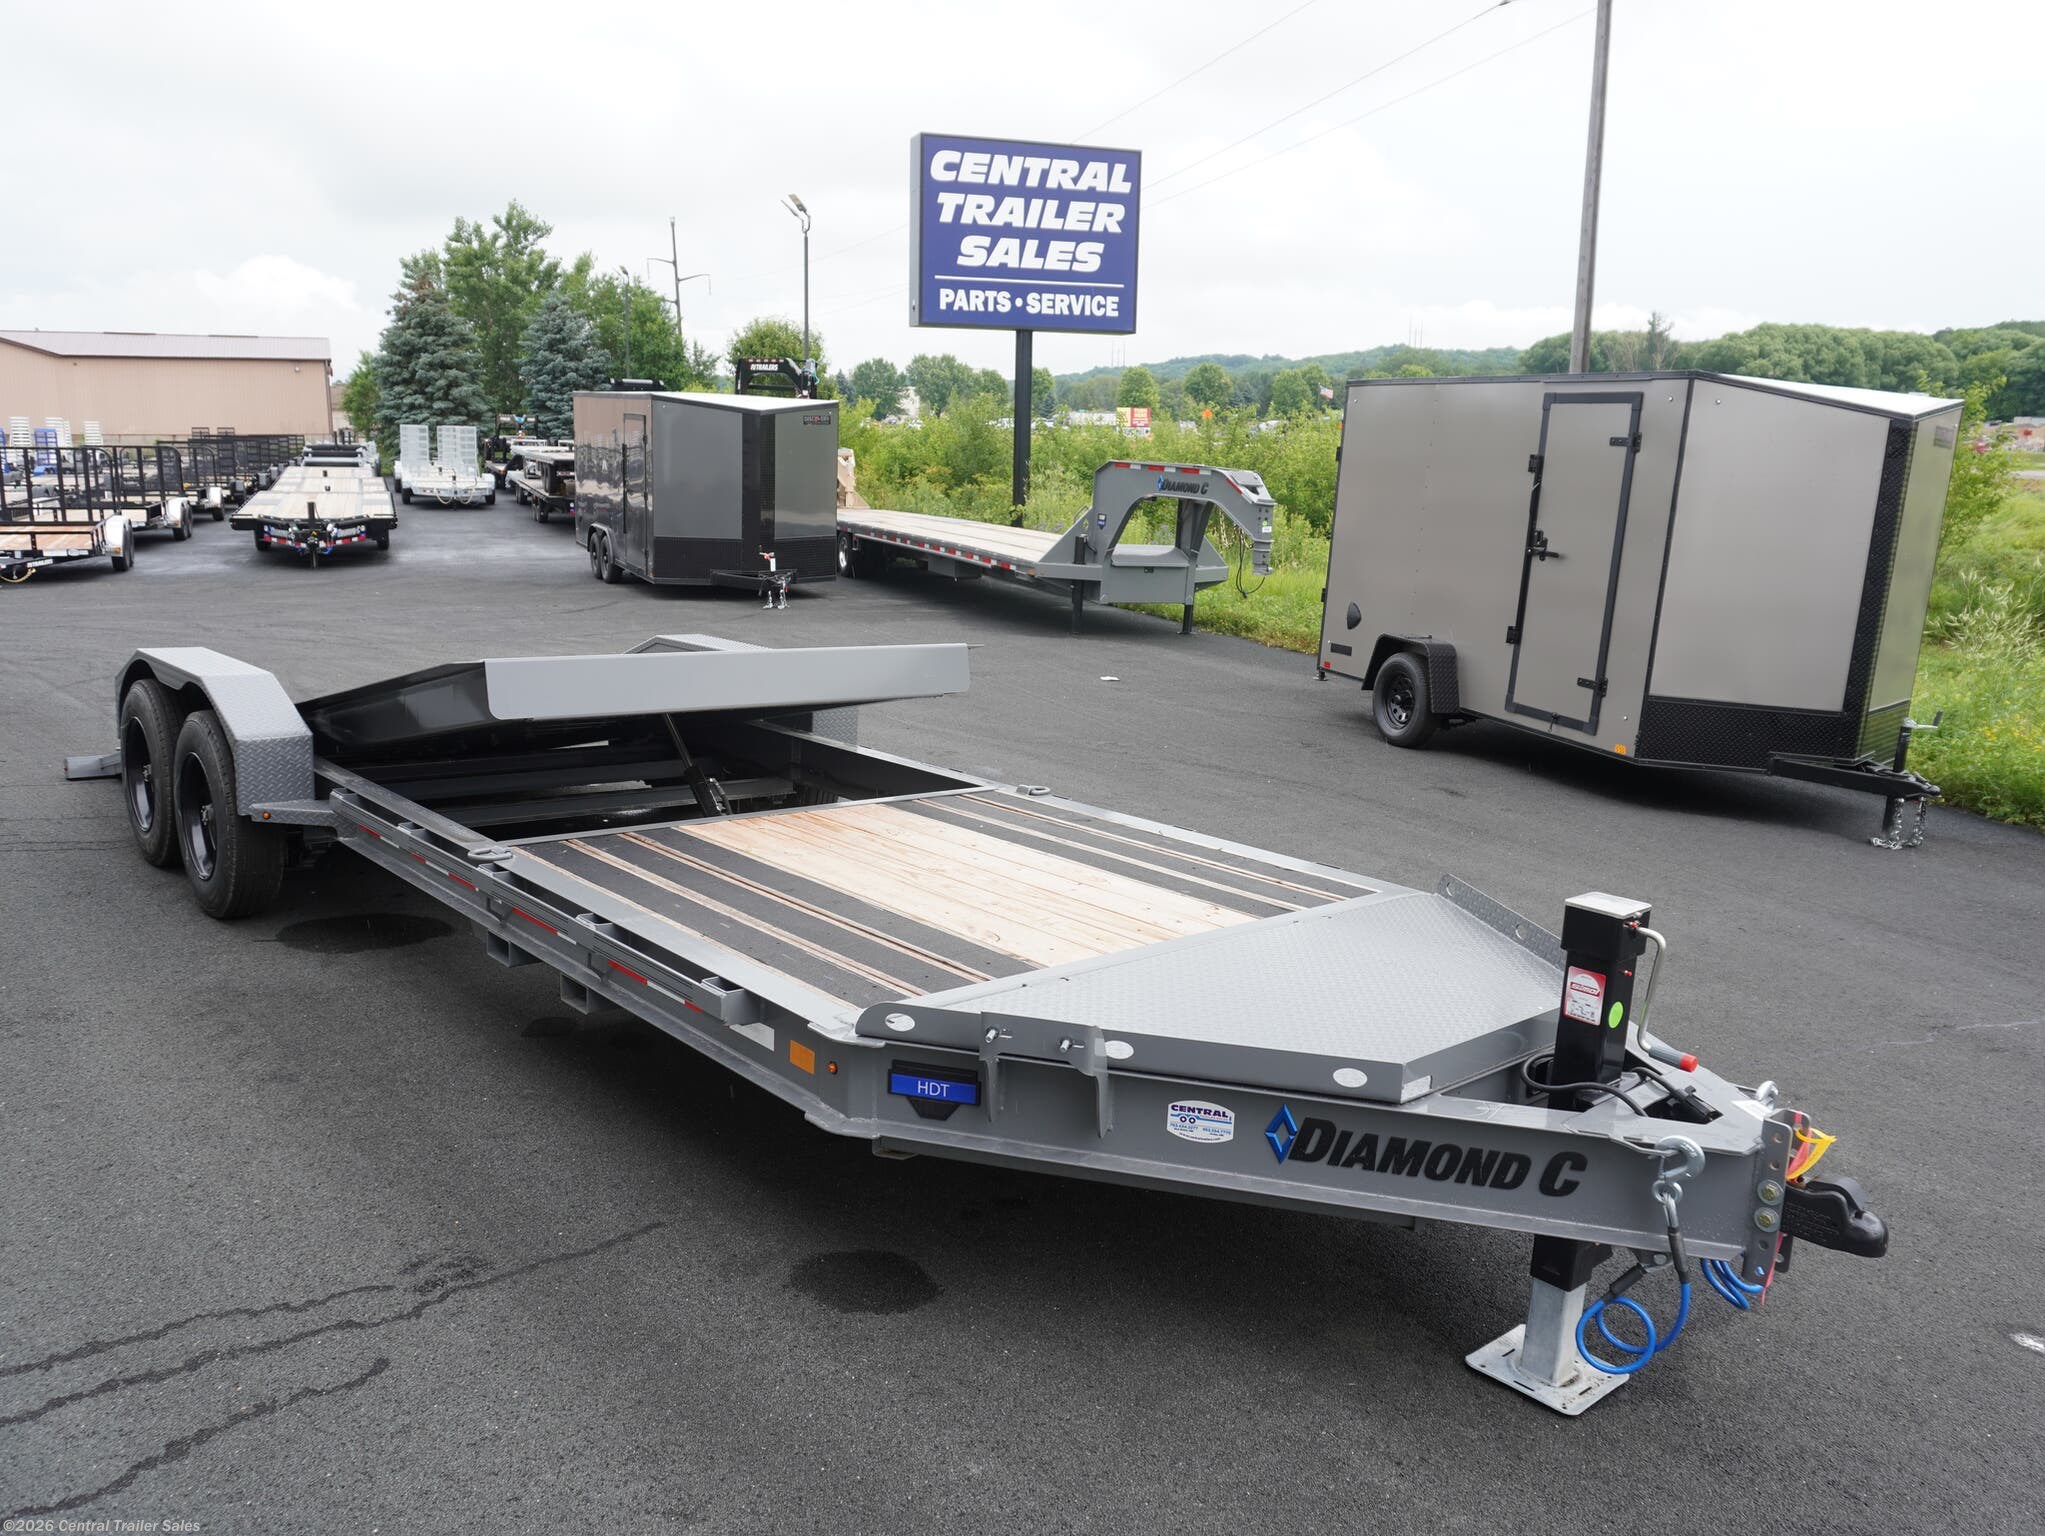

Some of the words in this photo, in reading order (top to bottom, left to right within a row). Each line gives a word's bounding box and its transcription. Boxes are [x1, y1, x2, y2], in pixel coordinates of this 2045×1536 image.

[930, 149, 1132, 193] CENTRAL
[937, 192, 1125, 233] TRAILER
[956, 235, 1104, 272] SALES
[940, 288, 1011, 312] PARTS
[1026, 292, 1119, 317] SERVICE
[1162, 478, 1200, 493] DIAMOND
[1200, 482, 1209, 495] C
[917, 1080, 950, 1097] HDT
[1171, 1104, 1228, 1118] CENTRAL
[1288, 1117, 1532, 1190] DIAMOND
[1539, 1151, 1588, 1197] C
